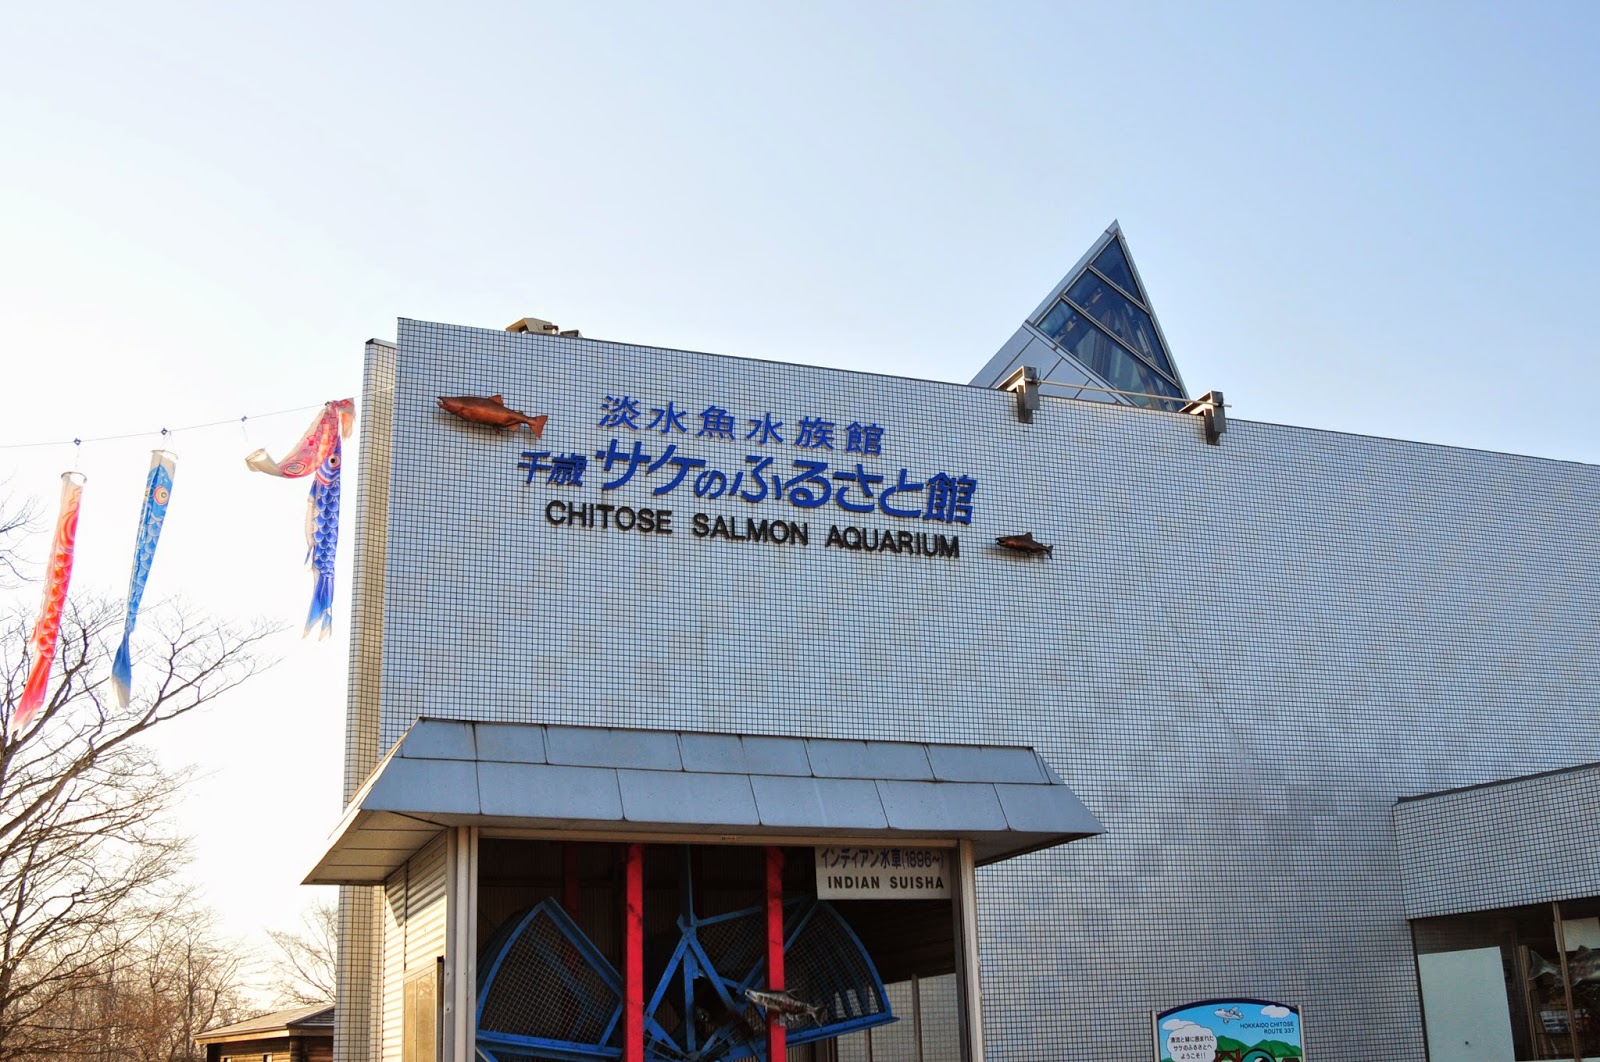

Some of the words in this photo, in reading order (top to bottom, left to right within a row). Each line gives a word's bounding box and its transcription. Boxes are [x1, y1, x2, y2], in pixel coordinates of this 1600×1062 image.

[599, 394, 886, 457] 淡水魚水族館
[546, 502, 674, 533] CHITOSE
[692, 515, 808, 547] SALMON
[826, 526, 961, 559] AQUARIUM
[828, 876, 880, 889] INDIAN
[889, 876, 944, 889] SUISHA
